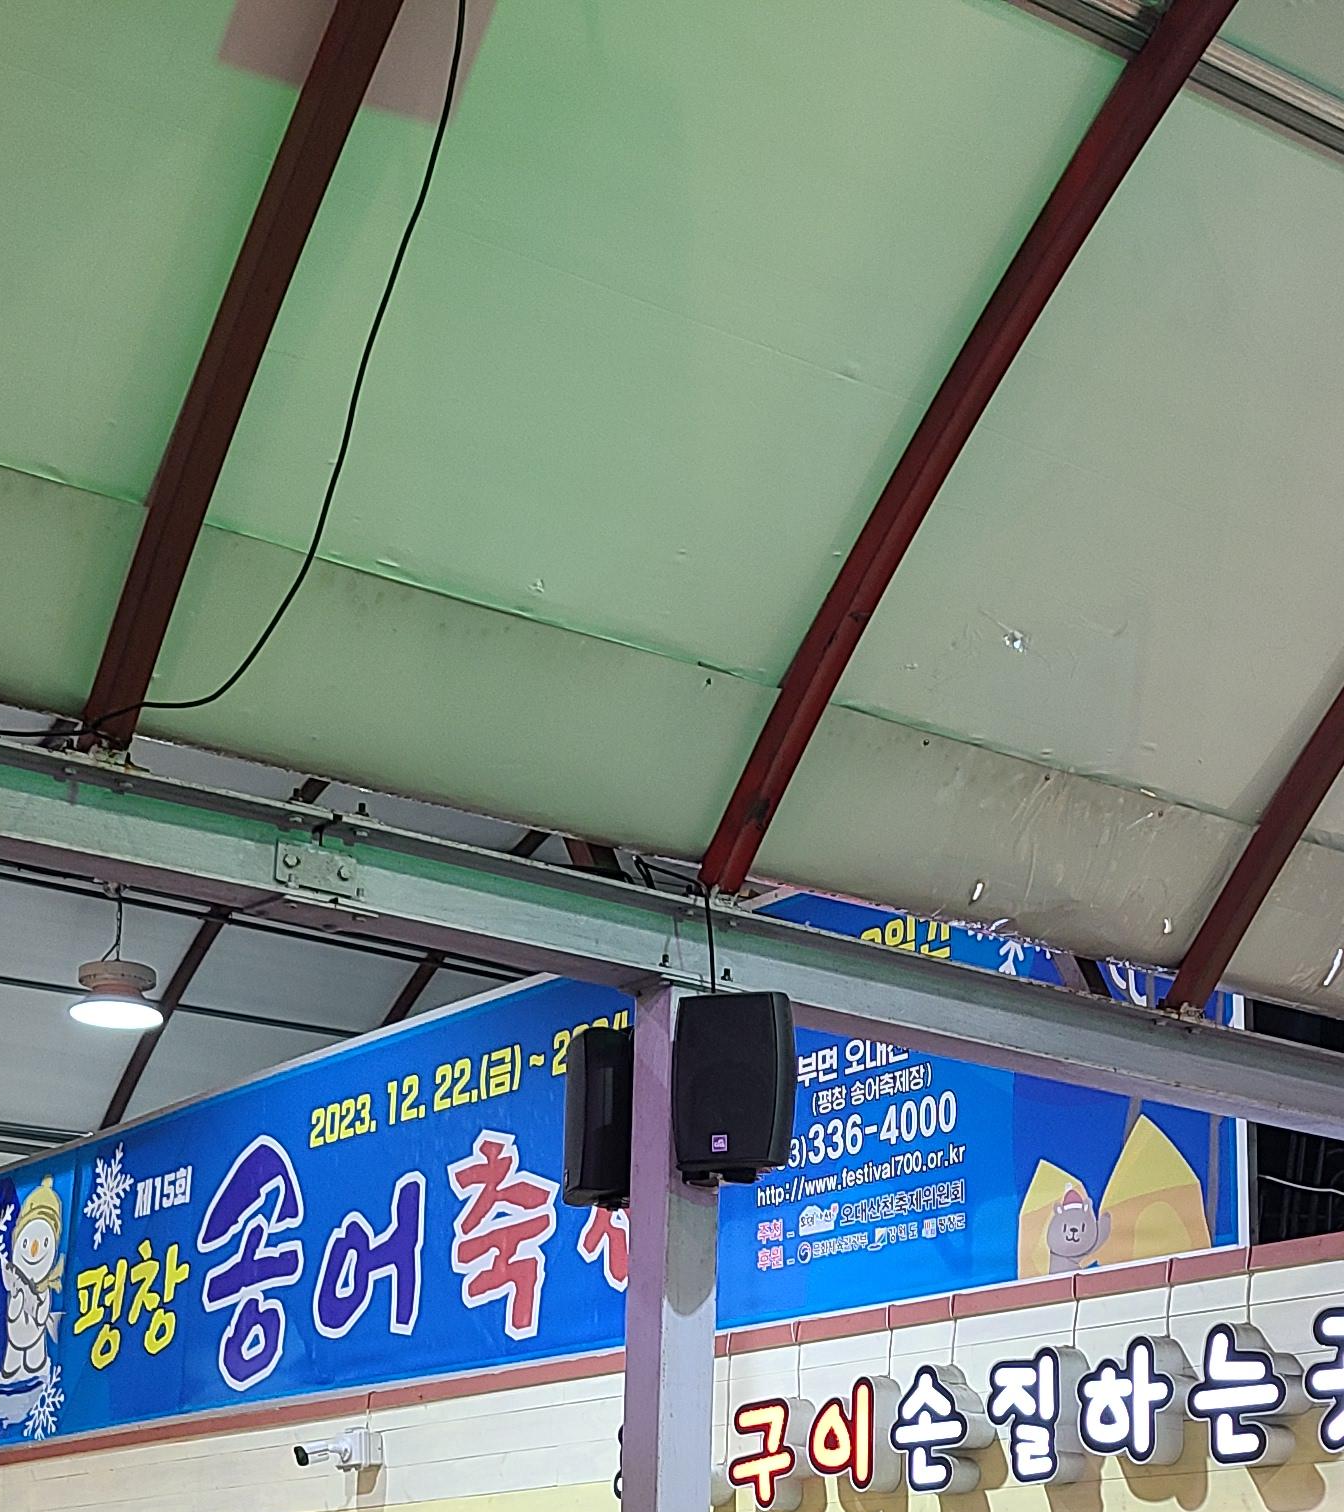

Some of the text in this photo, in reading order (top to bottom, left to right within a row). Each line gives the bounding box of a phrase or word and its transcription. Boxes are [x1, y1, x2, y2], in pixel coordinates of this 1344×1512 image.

[309, 1093, 377, 1148] 2023.
[387, 1074, 426, 1125] 12.
[433, 1043, 522, 1113] 22.(금)
[812, 1063, 932, 1116] (평창 송어축제장)
[775, 1091, 957, 1171] 3)336-4000
[133, 1165, 193, 1219] 제15회
[757, 1144, 966, 1206] http://www.festival700.or.kr
[757, 1246, 784, 1270] 후원
[73, 1238, 191, 1370] 평창
